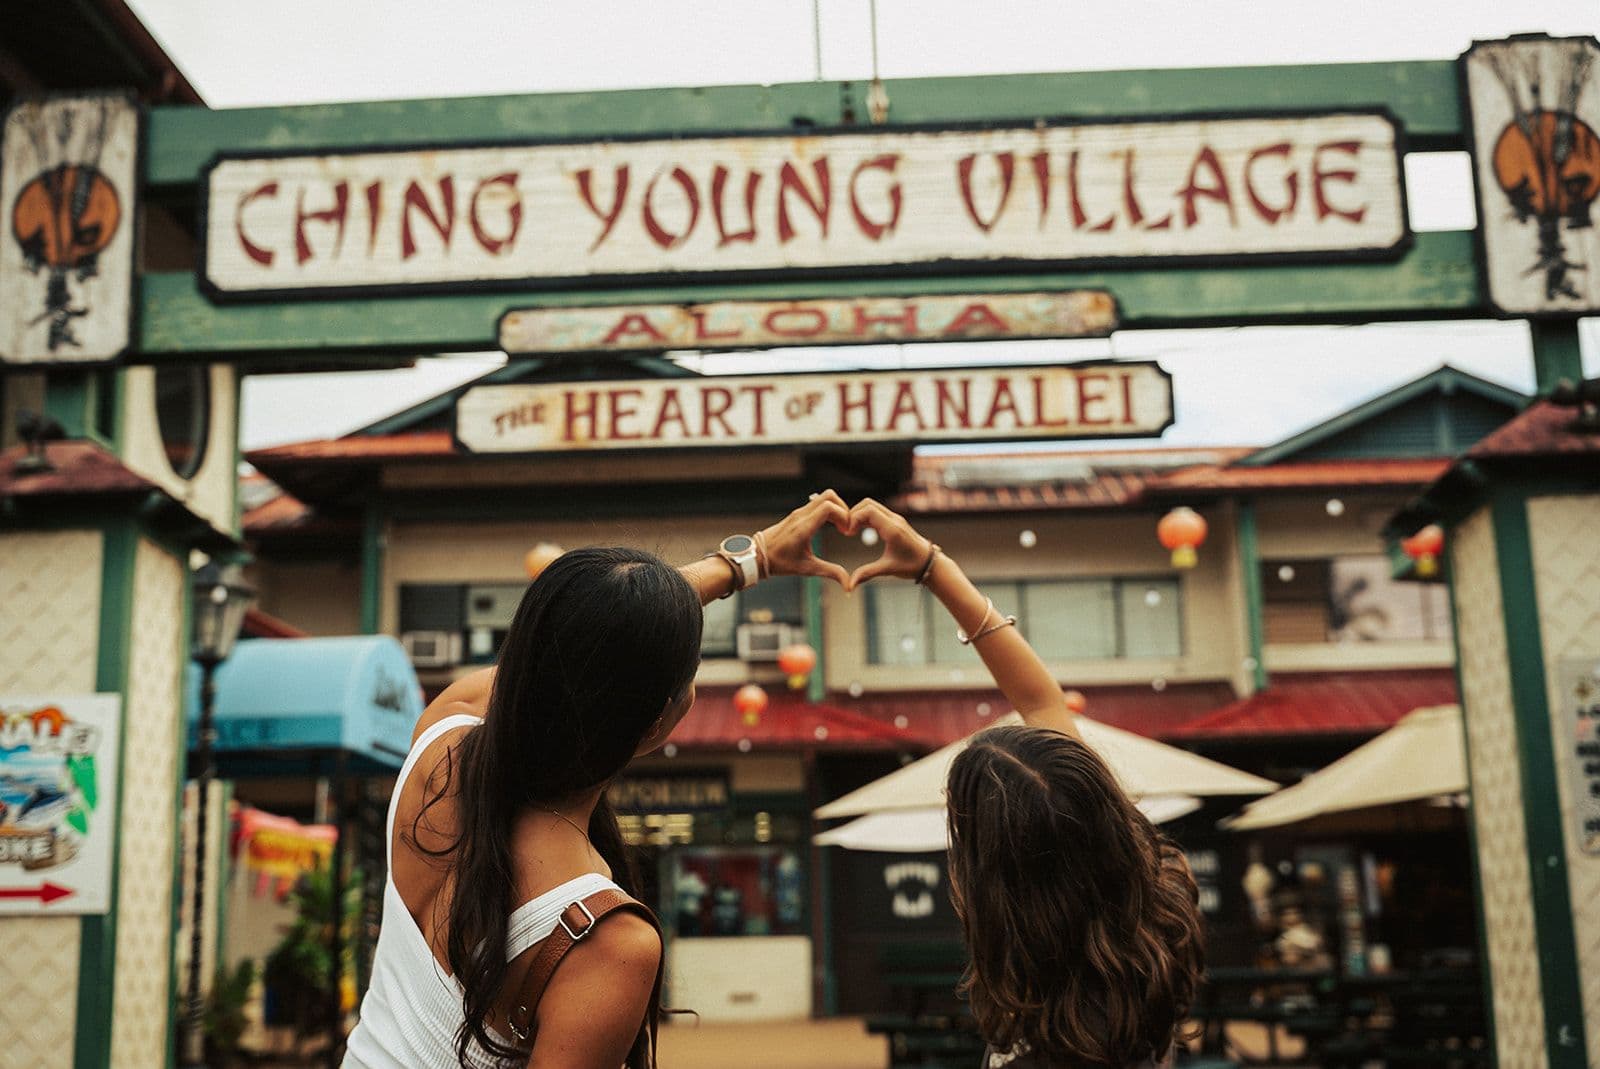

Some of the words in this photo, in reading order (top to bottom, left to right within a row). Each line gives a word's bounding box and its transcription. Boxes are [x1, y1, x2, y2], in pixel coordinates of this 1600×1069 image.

[234, 172, 524, 268] CHING
[572, 153, 904, 256] YOUNG
[956, 141, 1369, 236] VILLAGE
[602, 303, 1010, 345] ALOHA
[493, 401, 547, 436] THE
[561, 382, 775, 443] HEART
[784, 392, 823, 420] OF
[834, 373, 1137, 434] HANALEI
